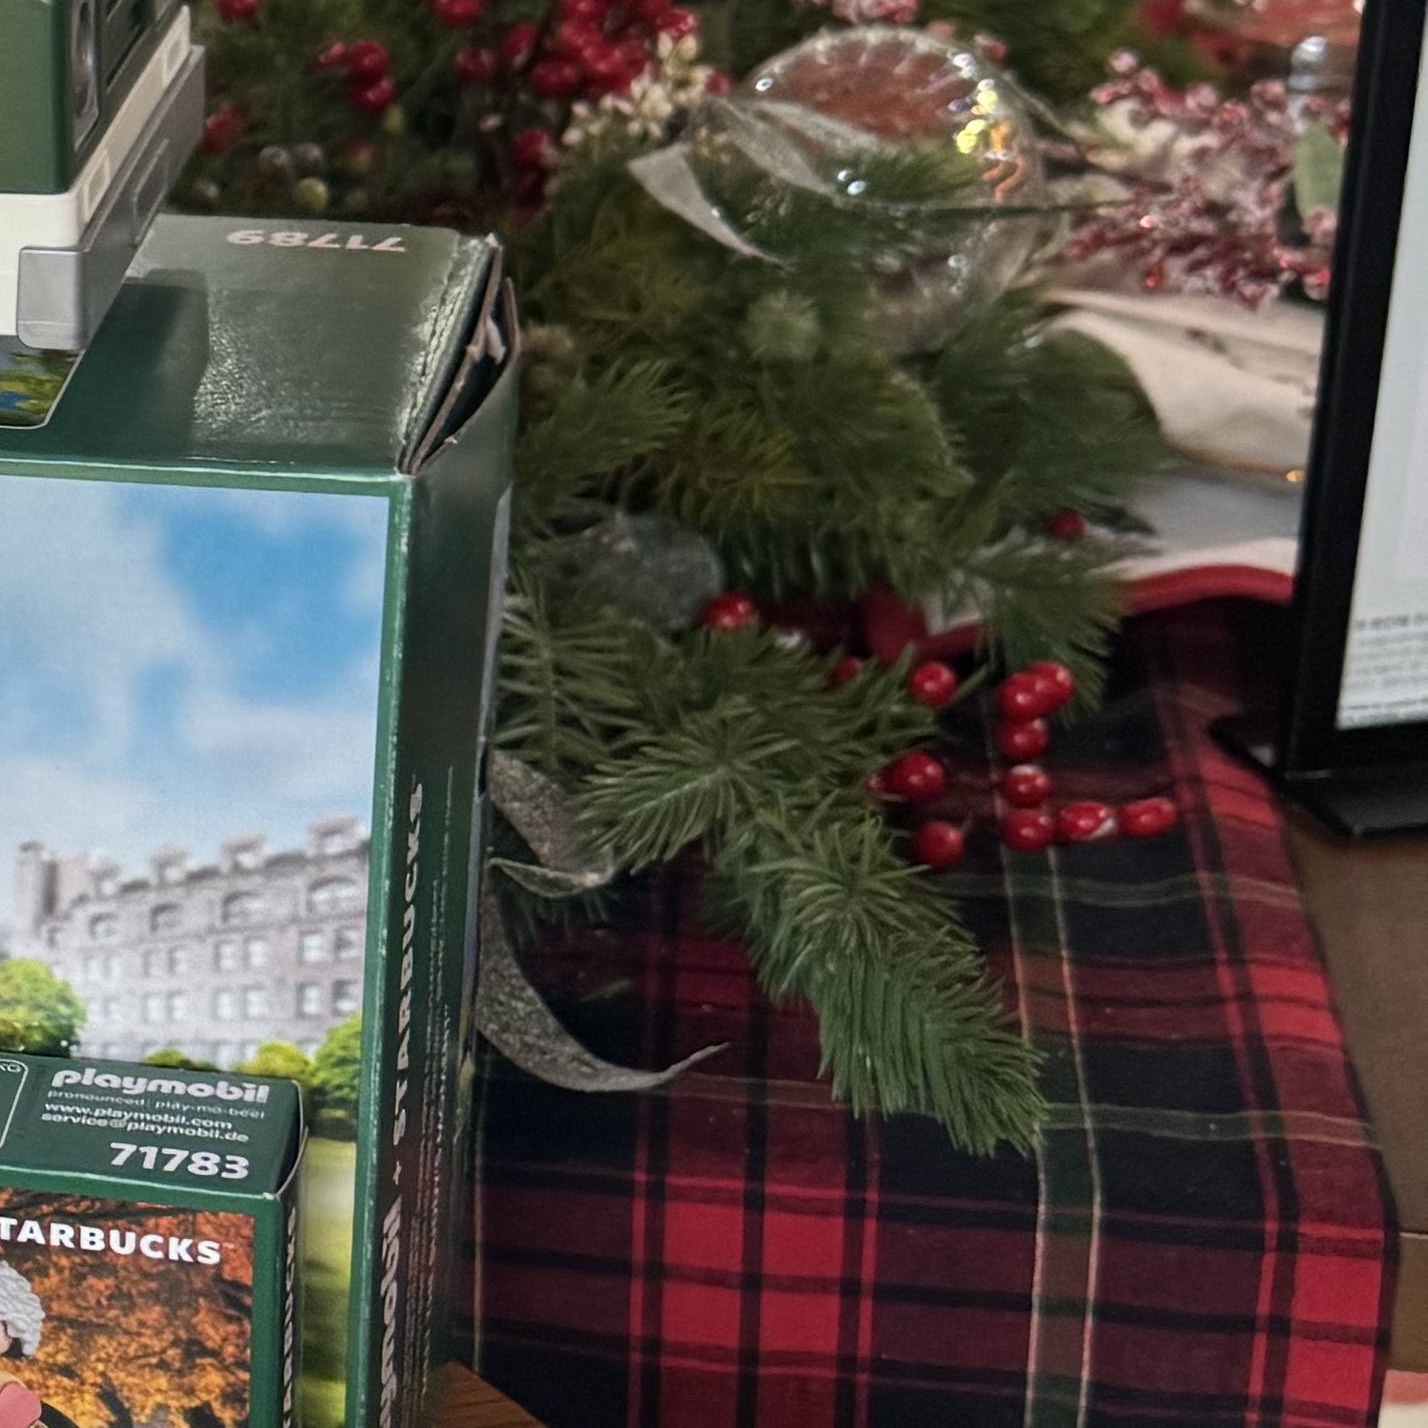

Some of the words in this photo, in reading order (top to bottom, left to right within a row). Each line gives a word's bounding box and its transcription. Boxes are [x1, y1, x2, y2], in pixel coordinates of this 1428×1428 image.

[51, 1068, 271, 1104] playmobil
[41, 1112, 250, 1143] service@playmobil.de
[44, 1102, 233, 1130] www.playmobil.com
[109, 1141, 250, 1180] 71783
